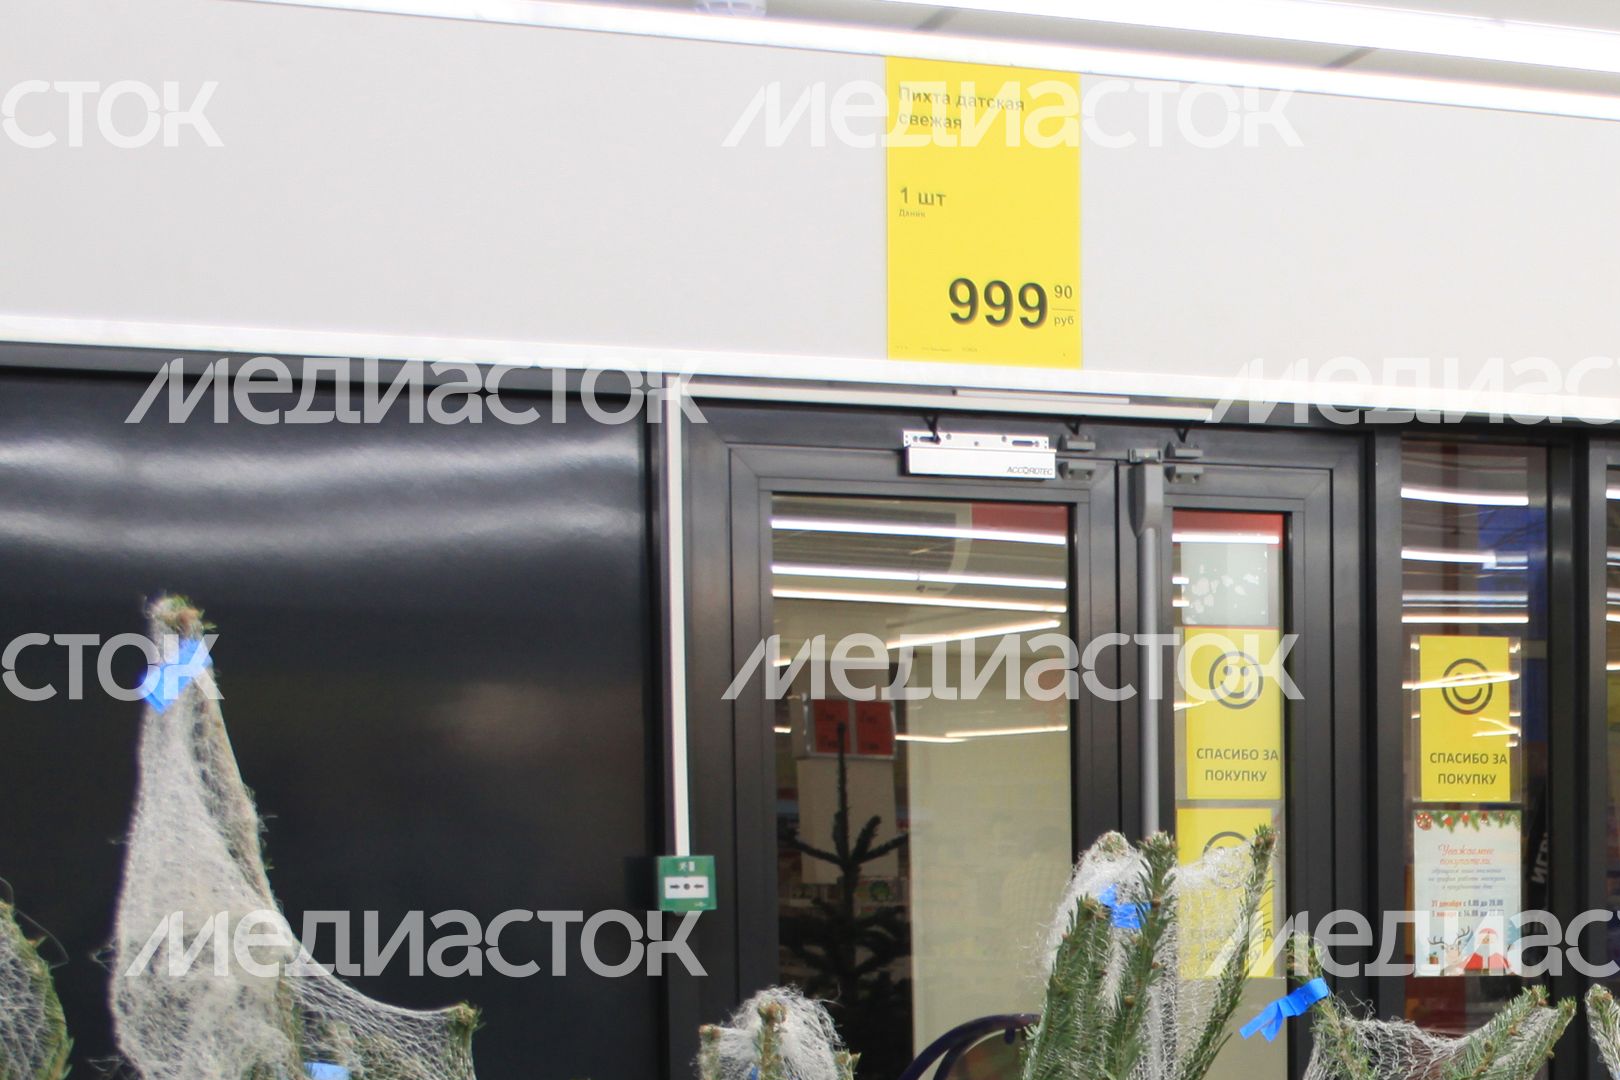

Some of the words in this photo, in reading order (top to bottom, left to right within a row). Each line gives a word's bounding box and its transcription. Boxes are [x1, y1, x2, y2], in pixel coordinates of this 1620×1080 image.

[898, 86, 951, 105] Пихта
[956, 95, 1025, 111] датская
[899, 113, 962, 129] свежая
[900, 186, 908, 204] 1
[918, 191, 947, 207] шт
[1054, 284, 1073, 300] 90
[948, 277, 1048, 329] 999
[1054, 314, 1075, 327] руб
[1196, 748, 1260, 761] СПАСИБО
[1263, 749, 1279, 761] ЗА
[1429, 752, 1489, 765] СПАСИБО
[1492, 753, 1508, 765] ЗА
[1204, 769, 1268, 782] ПОКУПКУ
[1437, 773, 1497, 785] ПОКУПКУ
